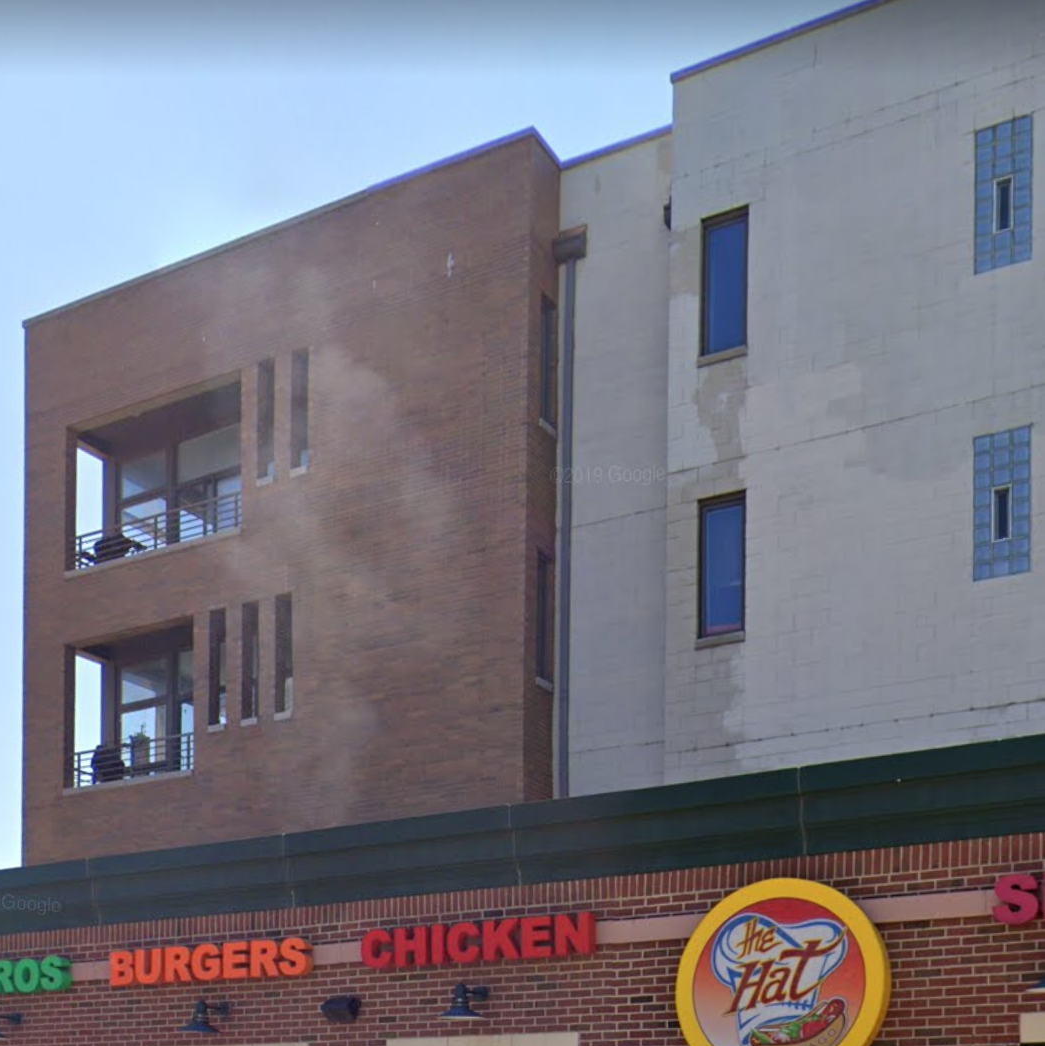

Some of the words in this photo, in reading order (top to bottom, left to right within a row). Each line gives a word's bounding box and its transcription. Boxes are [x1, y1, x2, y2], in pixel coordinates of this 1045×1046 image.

[109, 937, 315, 987] BURGERS
[360, 911, 597, 969] CHICKEN
[722, 925, 848, 1017] Hat
